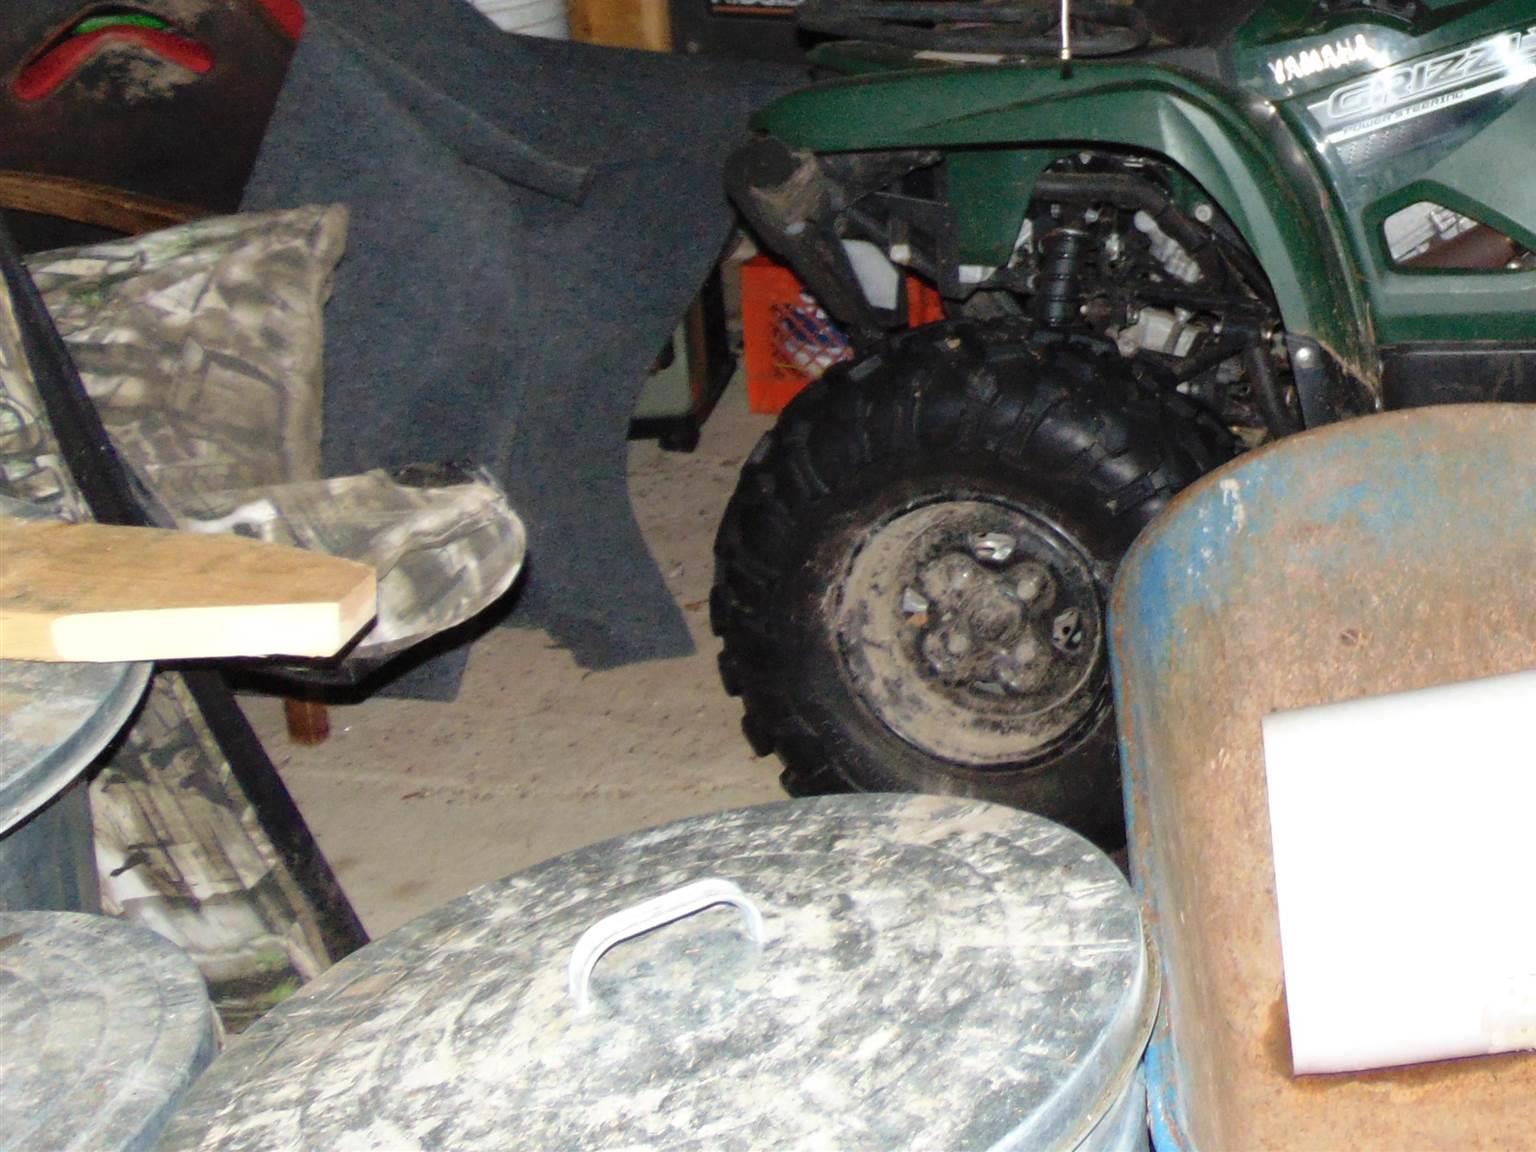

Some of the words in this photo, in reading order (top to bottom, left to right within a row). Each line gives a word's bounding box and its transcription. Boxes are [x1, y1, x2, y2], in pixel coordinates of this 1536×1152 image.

[1268, 34, 1376, 84] YAMAHA
[1343, 112, 1393, 135] POWER
[1398, 90, 1465, 119] STEERING
